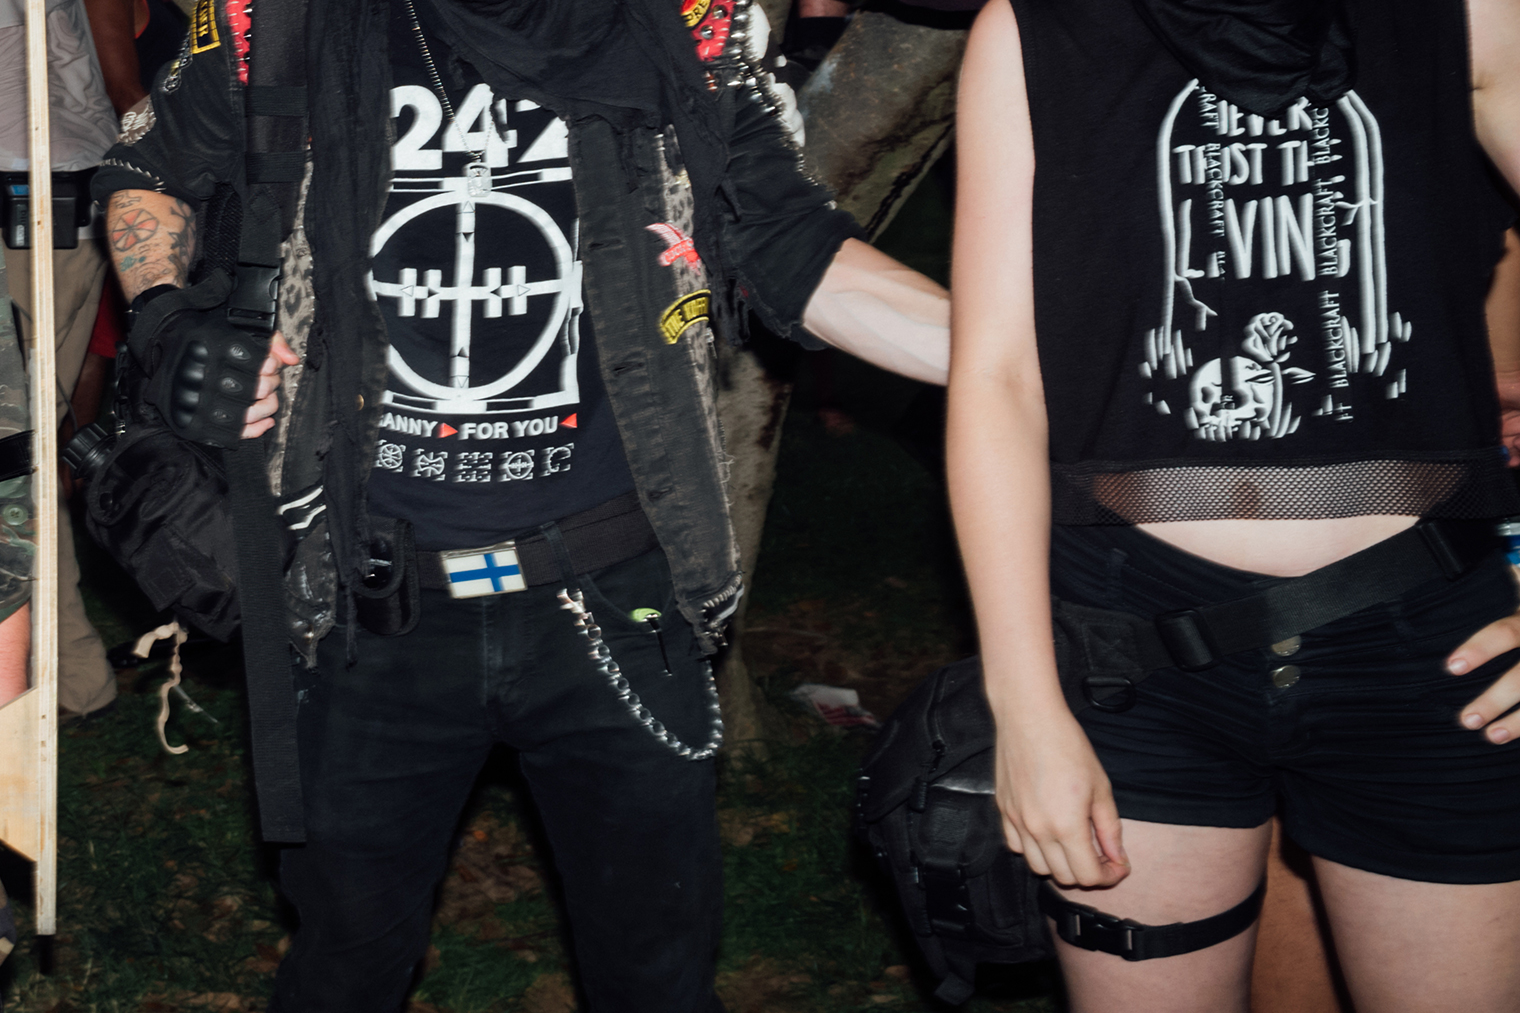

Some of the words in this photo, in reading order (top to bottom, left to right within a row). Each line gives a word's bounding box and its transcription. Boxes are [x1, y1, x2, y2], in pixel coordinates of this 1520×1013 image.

[1314, 178, 1339, 276] BLACKCRAFT
[1320, 290, 1350, 388] BLACKCRAFT
[380, 411, 438, 437] ANNY
[458, 422, 509, 440] FOR
[511, 415, 559, 436] YOU
